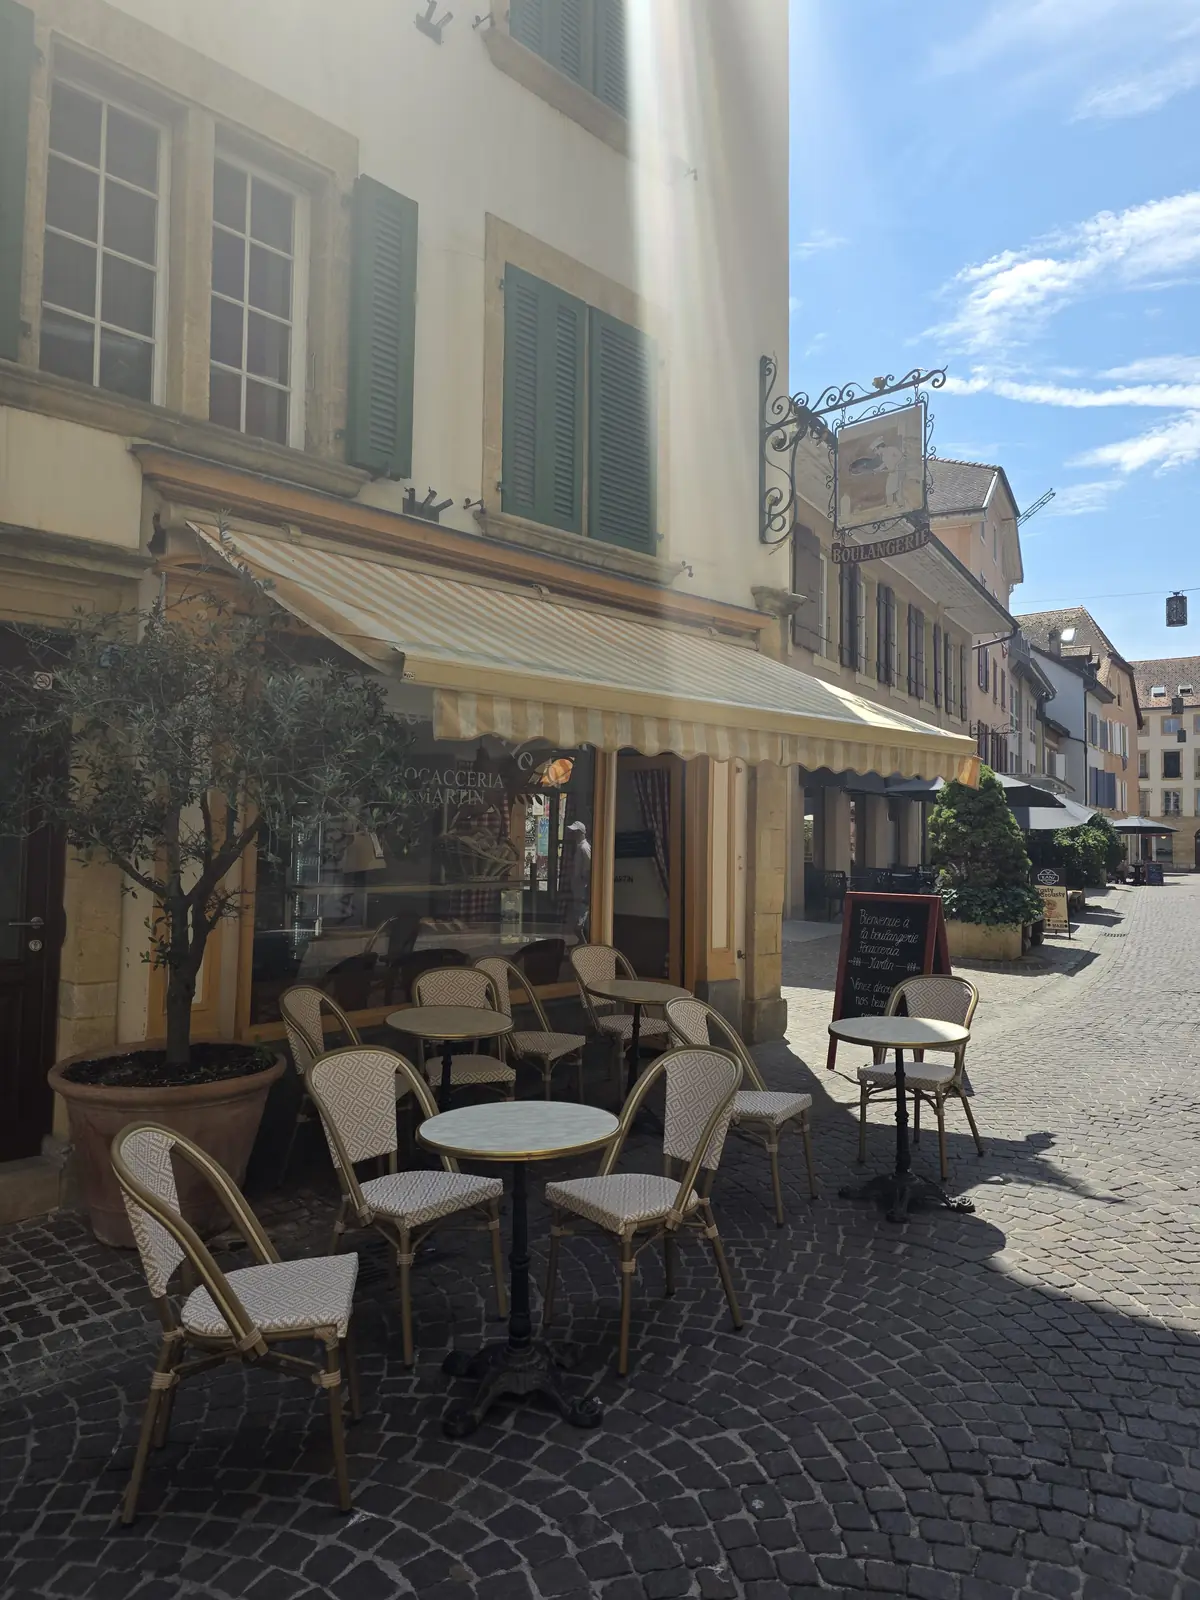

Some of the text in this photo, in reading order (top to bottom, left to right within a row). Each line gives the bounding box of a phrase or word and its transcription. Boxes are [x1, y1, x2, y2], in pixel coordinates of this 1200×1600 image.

[832, 529, 930, 563] BOULANGERIE
[395, 766, 504, 789] OCACCERIA
[859, 908, 901, 928] Bienvenue
[860, 927, 919, 946] la boulangerie
[855, 996, 869, 1006] nos
